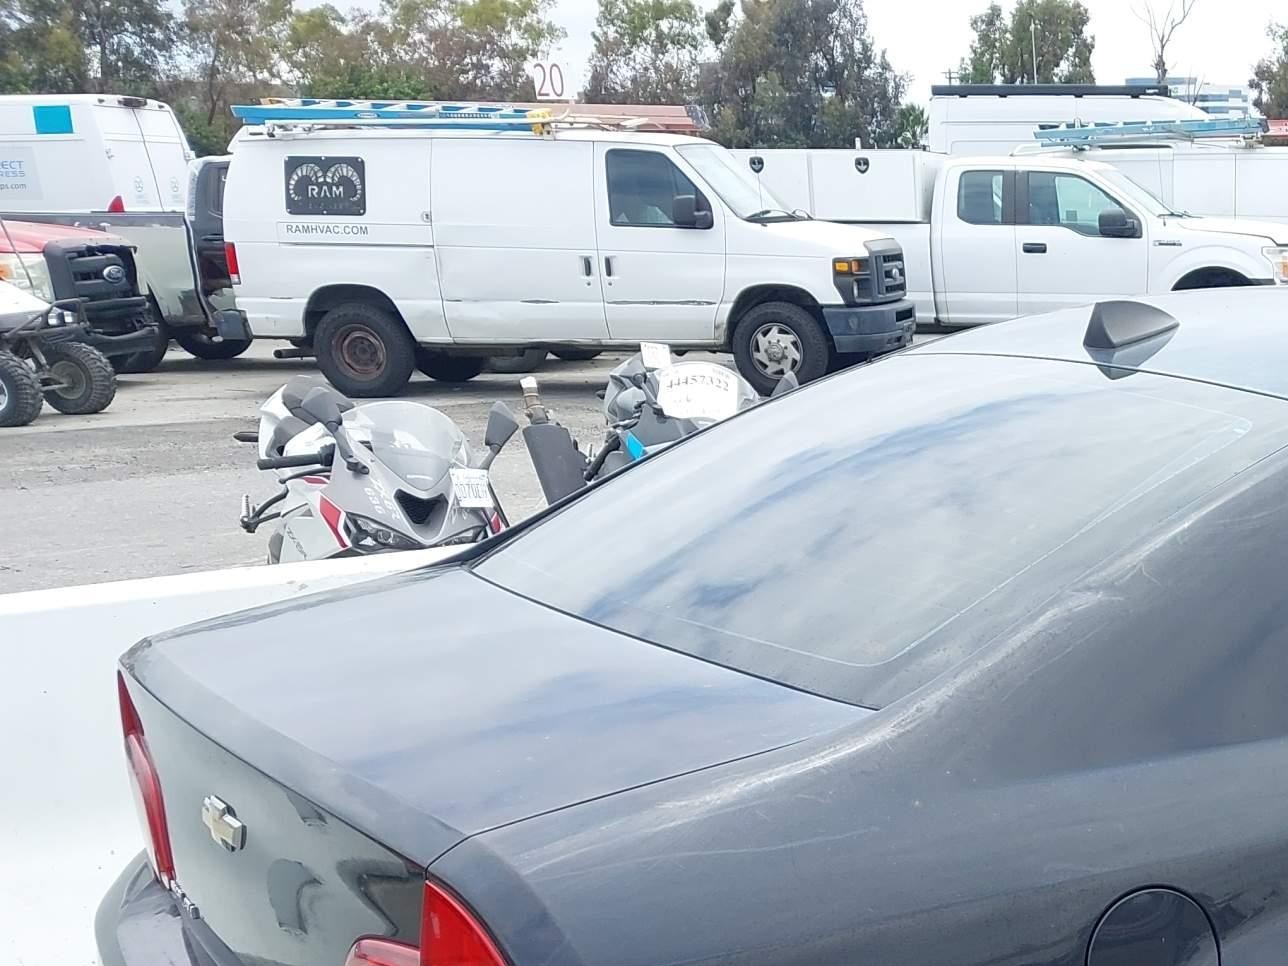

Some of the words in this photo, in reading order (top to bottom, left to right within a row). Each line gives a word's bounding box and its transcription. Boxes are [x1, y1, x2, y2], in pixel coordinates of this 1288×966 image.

[533, 63, 564, 97] 20
[308, 185, 344, 198] RAM
[286, 224, 369, 236] RAMHVAC.COM
